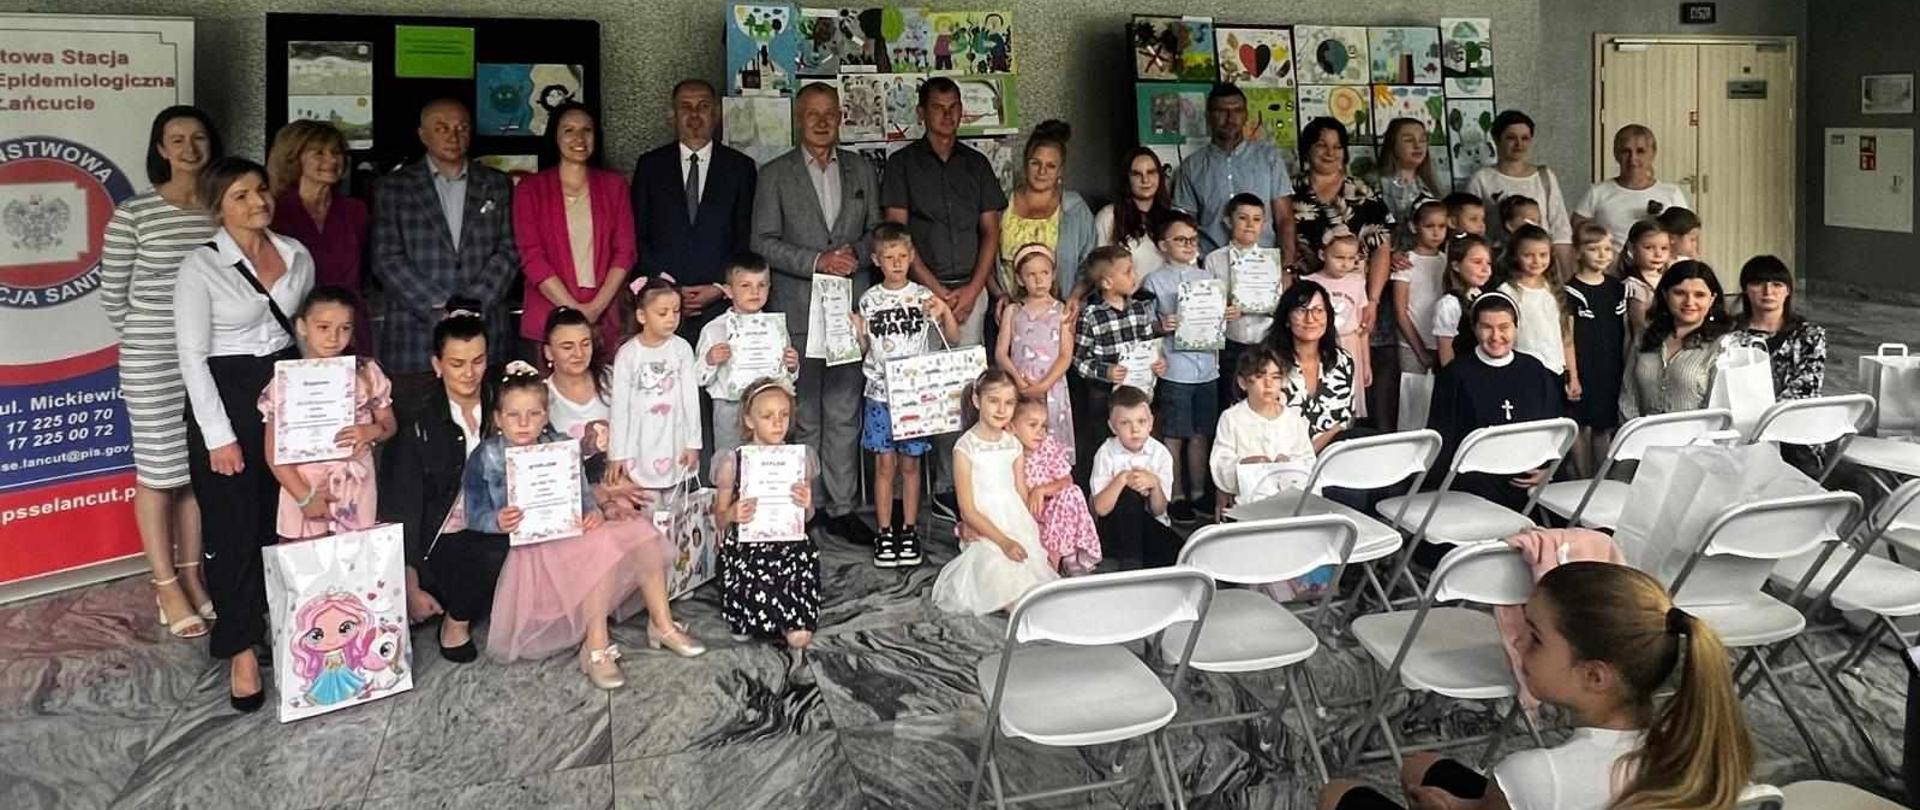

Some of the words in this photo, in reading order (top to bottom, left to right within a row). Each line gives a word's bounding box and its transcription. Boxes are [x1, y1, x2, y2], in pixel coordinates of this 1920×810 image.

[62, 49, 129, 68] Stacja
[0, 73, 175, 91] Epidemiologiczna
[872, 306, 923, 323] STAR
[869, 319, 924, 338] WARS
[0, 400, 23, 416] ul.
[7, 420, 27, 434] 17
[32, 415, 63, 430] 225
[68, 411, 88, 425] 00
[94, 408, 113, 421] 70
[7, 437, 28, 451] 17
[33, 431, 64, 447] 225
[69, 428, 89, 441] 00
[94, 424, 113, 437] 72
